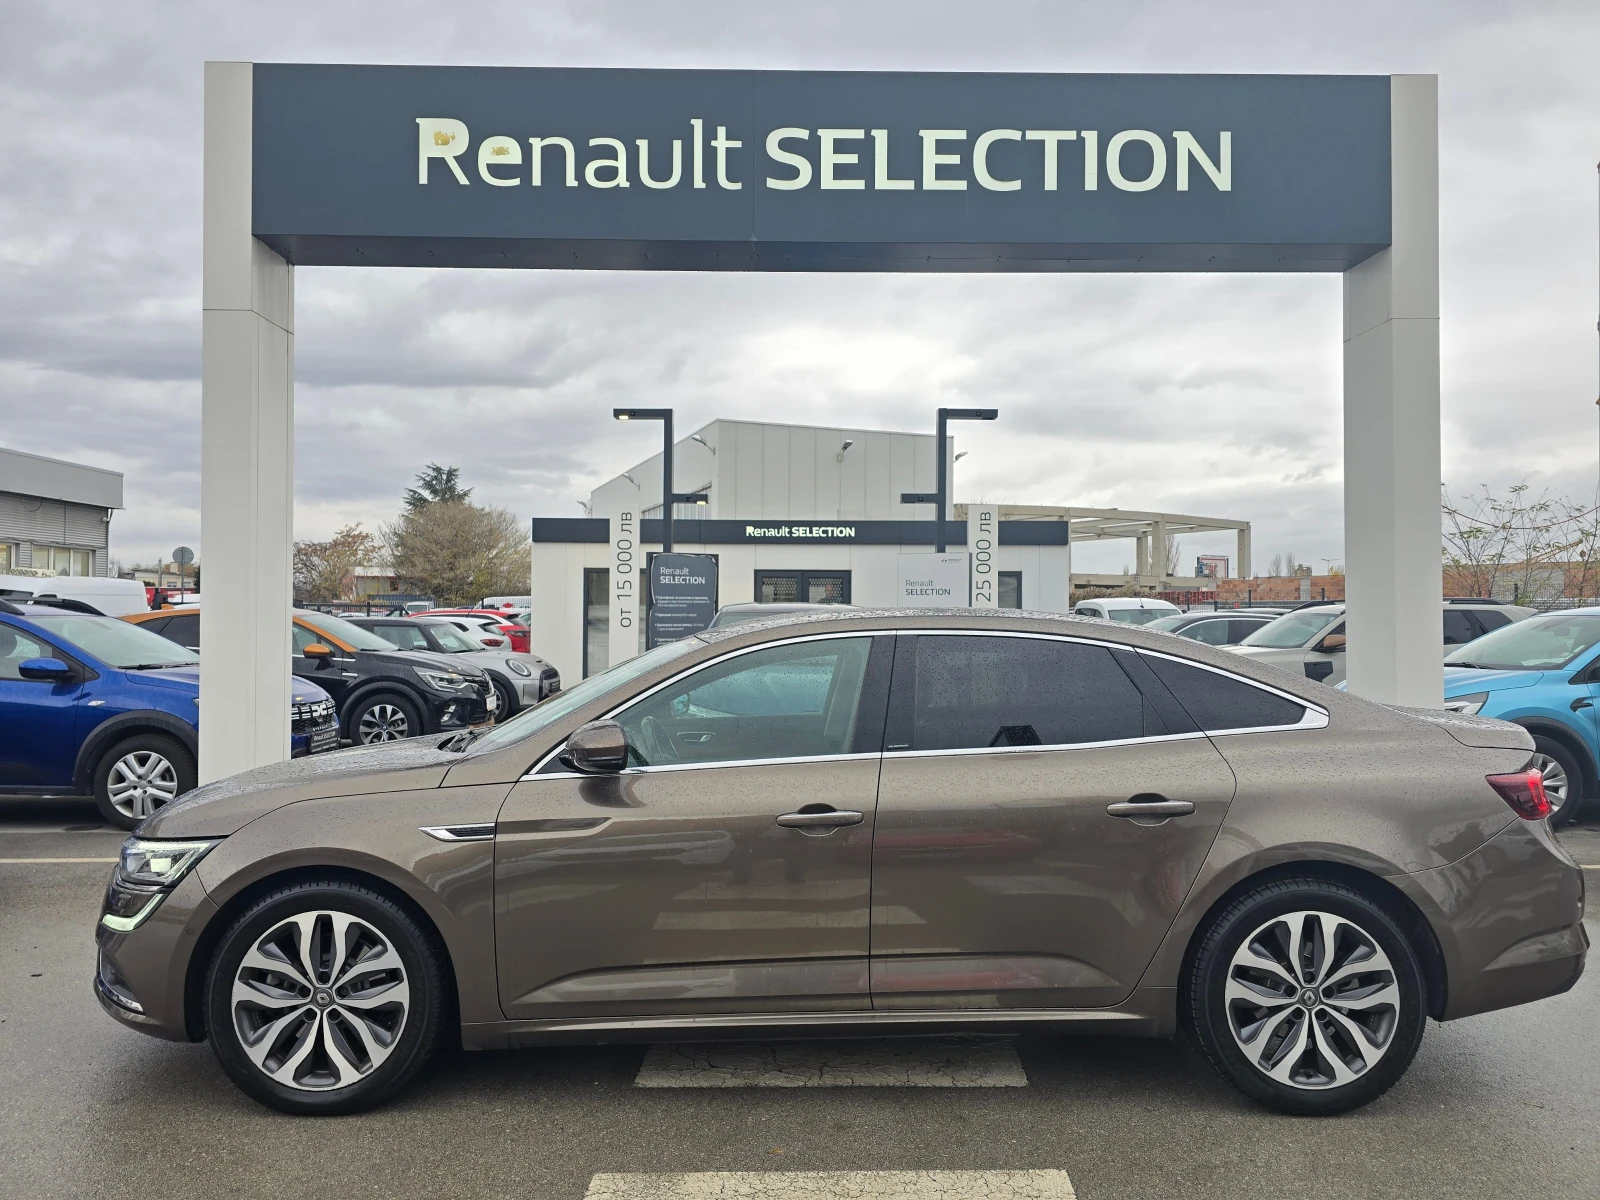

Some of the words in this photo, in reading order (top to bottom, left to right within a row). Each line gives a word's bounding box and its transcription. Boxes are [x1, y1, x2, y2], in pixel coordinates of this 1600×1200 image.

[415, 117, 743, 190] Renault
[765, 127, 1232, 193] SELECTION
[745, 525, 790, 537] Renault
[791, 526, 855, 537] SELECTION
[616, 539, 632, 574] 000
[976, 539, 991, 574] 000
[660, 566, 690, 575] Renault
[660, 575, 706, 585] SELECTION
[905, 579, 934, 587] Renault
[616, 580, 632, 601] 15
[905, 588, 951, 596] SELECTION
[976, 580, 991, 602] 25
